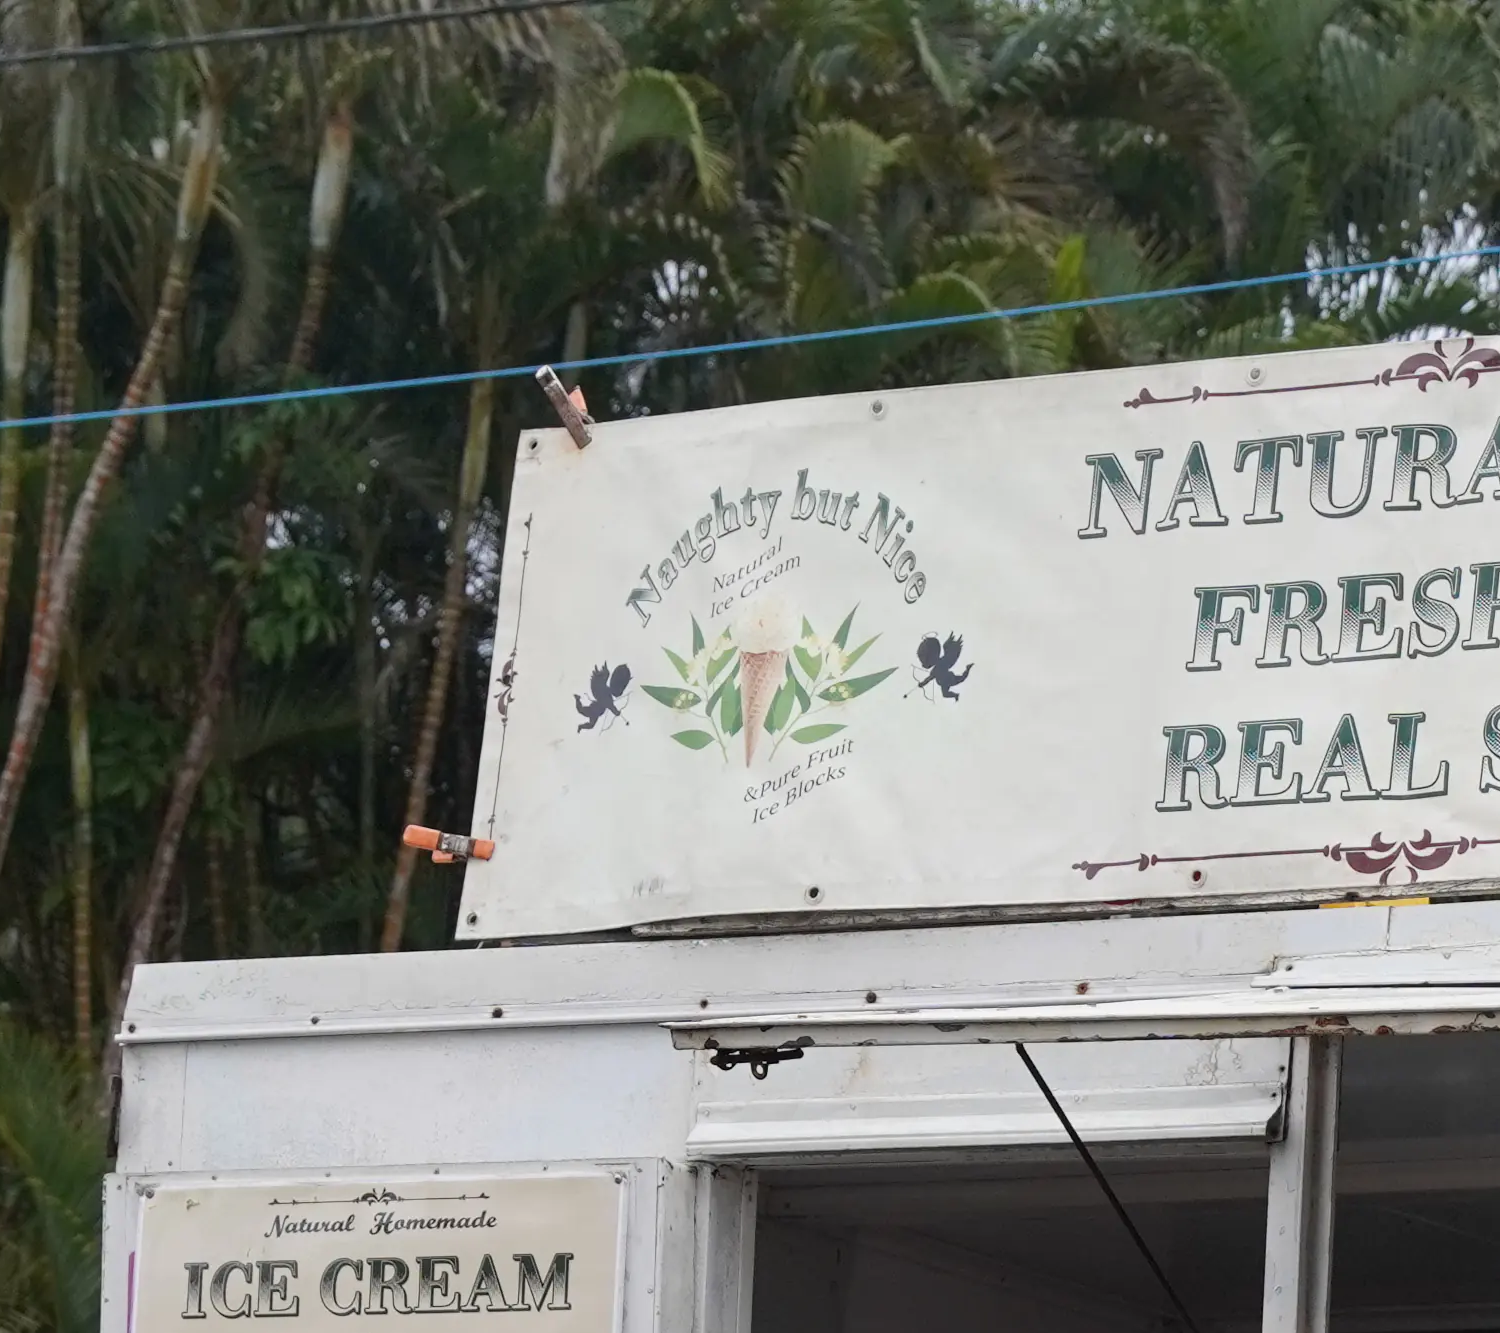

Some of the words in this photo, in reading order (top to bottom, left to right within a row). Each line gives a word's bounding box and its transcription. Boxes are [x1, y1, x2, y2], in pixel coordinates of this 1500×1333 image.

[626, 486, 782, 628] Naughty
[790, 468, 859, 530] but
[859, 492, 926, 604] Nice
[713, 537, 782, 593] Natural
[710, 594, 734, 619] Ice
[740, 555, 801, 598] Cream
[806, 739, 854, 772] Fruit
[1158, 709, 1450, 814] REAL
[752, 799, 779, 824] Ice
[786, 765, 846, 807] Blocks
[263, 1212, 356, 1239] Natural
[368, 1210, 498, 1236] Homemade
[182, 1259, 299, 1319] ICE
[319, 1252, 575, 1317] CREAM
